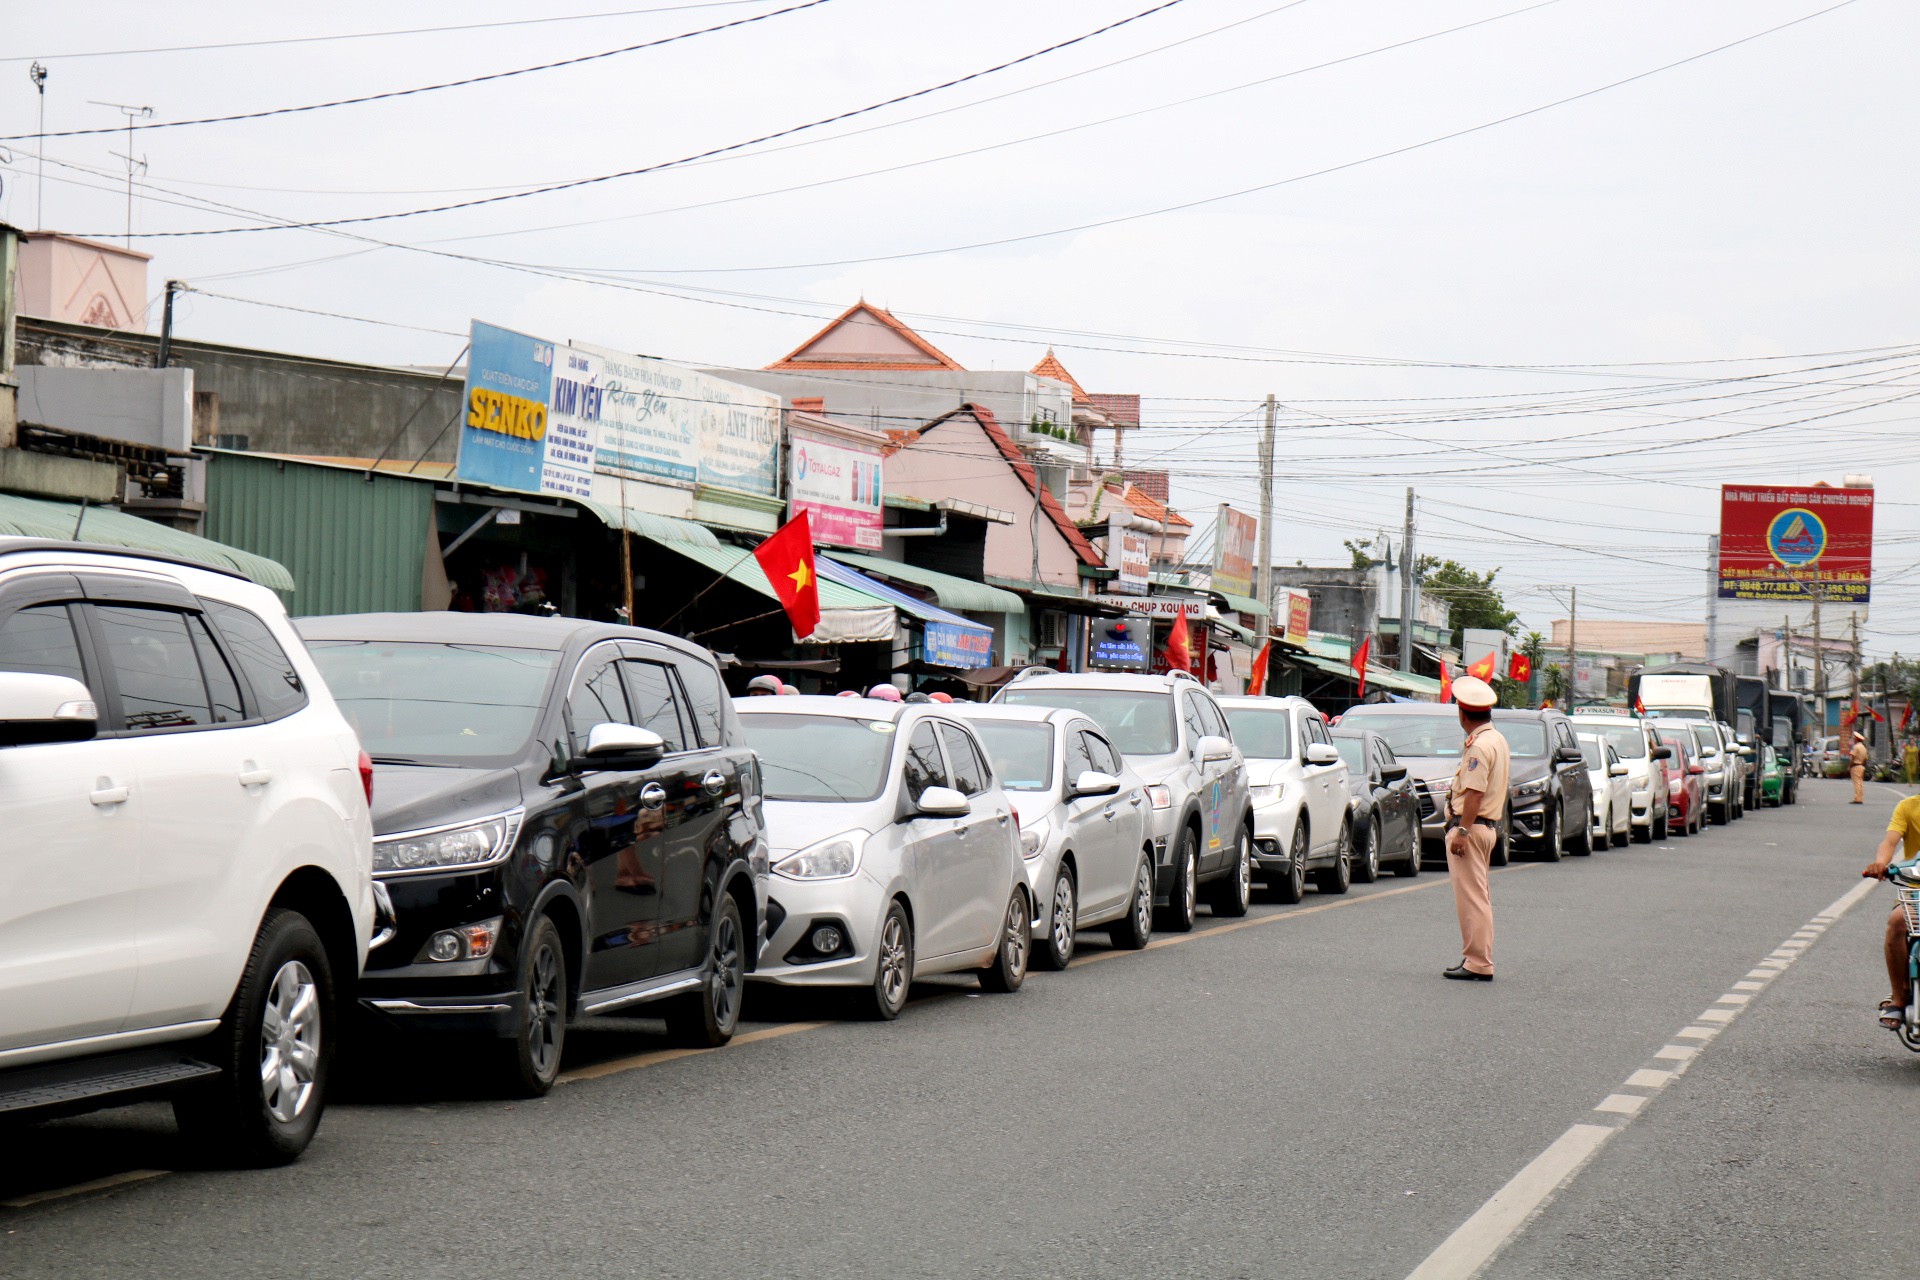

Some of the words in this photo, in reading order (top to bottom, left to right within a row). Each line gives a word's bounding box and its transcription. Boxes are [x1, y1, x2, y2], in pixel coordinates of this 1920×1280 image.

[554, 376, 578, 415] KIM
[580, 374, 602, 422] YẾN
[606, 380, 636, 408] Kim
[467, 386, 548, 442] SENKO
[726, 409, 748, 439] ANH
[808, 458, 840, 478] TOTALGAZ
